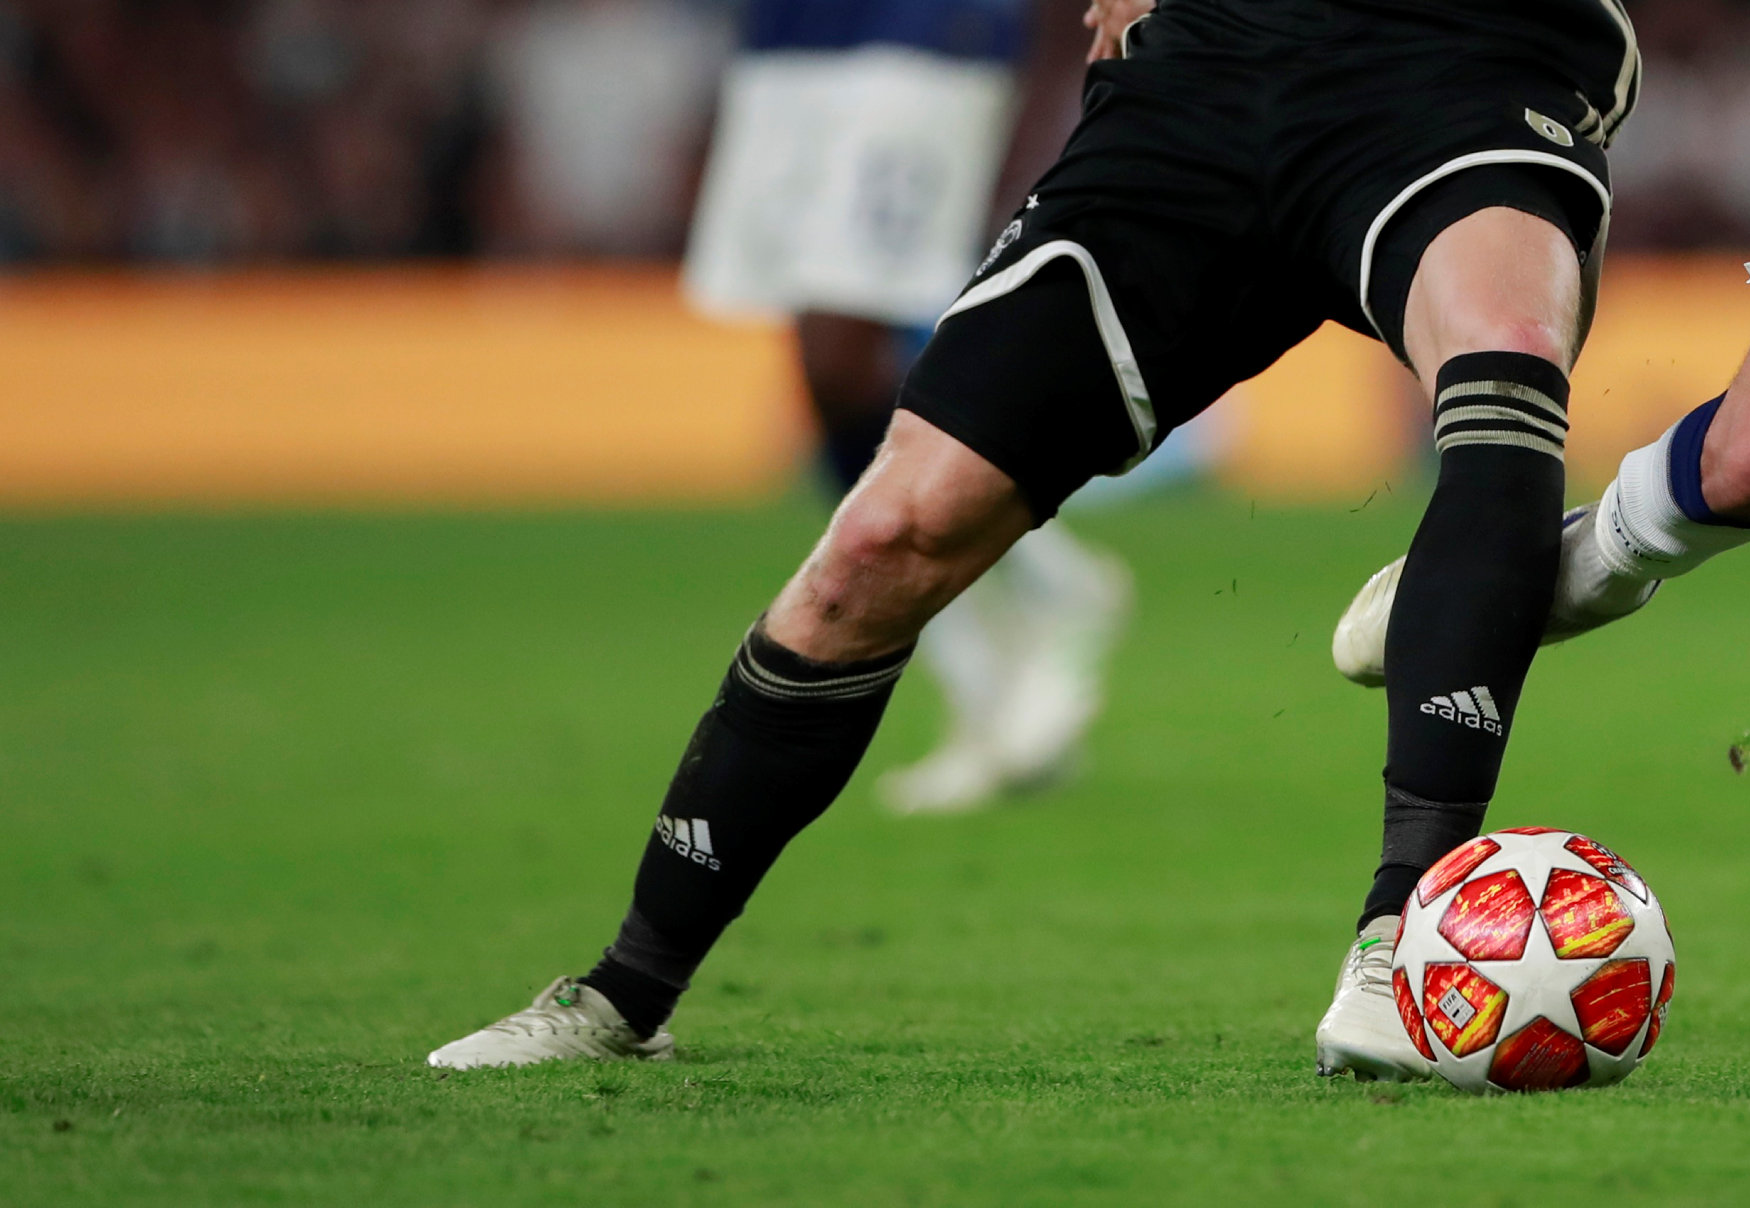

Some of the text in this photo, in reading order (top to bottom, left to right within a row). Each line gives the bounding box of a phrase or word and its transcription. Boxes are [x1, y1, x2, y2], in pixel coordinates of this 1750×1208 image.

[1524, 107, 1575, 147] 6
[1420, 702, 1503, 737] adidas
[655, 815, 722, 871] adidas
[1442, 993, 1457, 1010] FIFA
